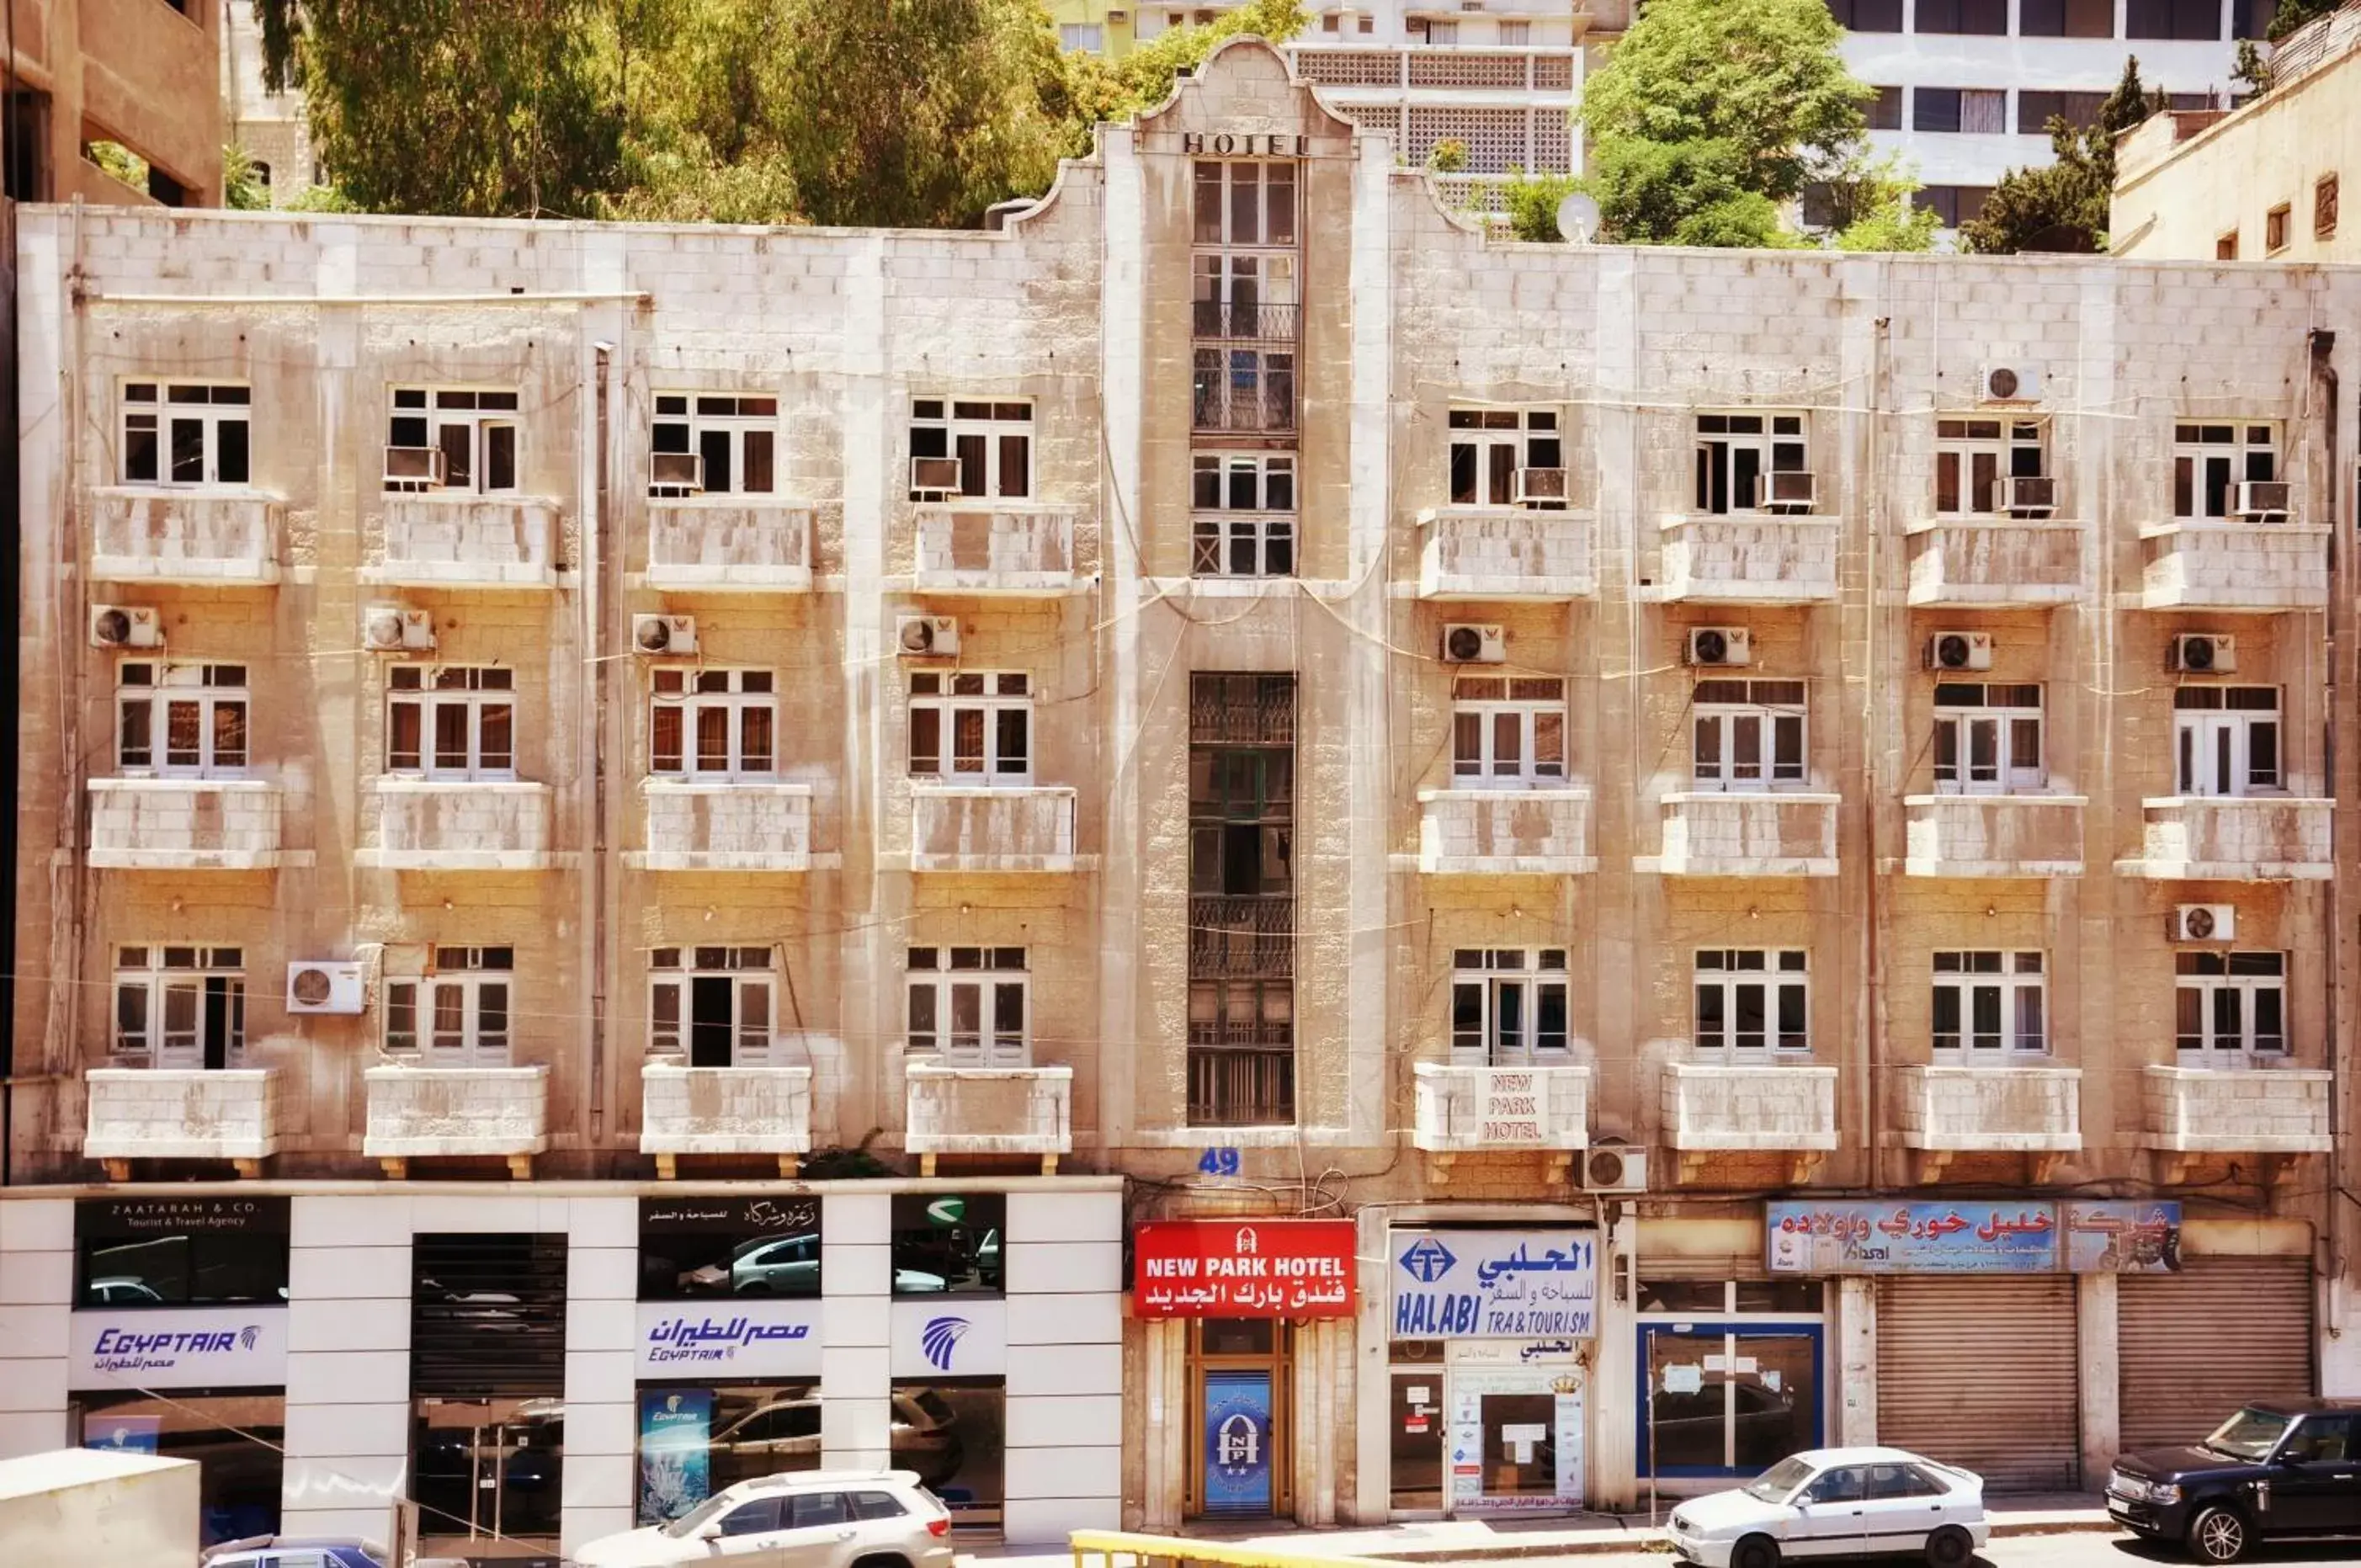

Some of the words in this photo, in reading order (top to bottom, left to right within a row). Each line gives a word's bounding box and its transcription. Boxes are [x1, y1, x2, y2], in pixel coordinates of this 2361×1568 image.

[1183, 132, 1310, 157] HOTEL
[1490, 1074, 1534, 1092] NEW
[1488, 1097, 1536, 1115] PARK
[1484, 1121, 1541, 1140] HOTEL
[1199, 1146, 1240, 1176] 49
[127, 1218, 162, 1227] Tourist
[176, 1217, 205, 1226] Travel
[209, 1216, 245, 1226] Agency
[1877, 1207, 1970, 1241] خوري
[1976, 1209, 2054, 1242] خليل
[1146, 1258, 1198, 1277] NEW
[1205, 1258, 1266, 1277] PARK
[1274, 1258, 1345, 1277] HOTEL
[1477, 1240, 1592, 1289] الحلبي
[1146, 1284, 1226, 1310] الجديد
[1233, 1282, 1284, 1310] بارك
[1290, 1279, 1346, 1308] فندق
[1489, 1278, 1527, 1305] السفر
[1529, 1289, 1537, 1306] و
[1542, 1279, 1593, 1303] للسياحة
[1396, 1293, 1481, 1334] HALABI
[649, 1318, 748, 1347] للطيران
[742, 1324, 811, 1346] مصر
[94, 1357, 144, 1372] للطيران
[140, 1358, 175, 1371] مصر
